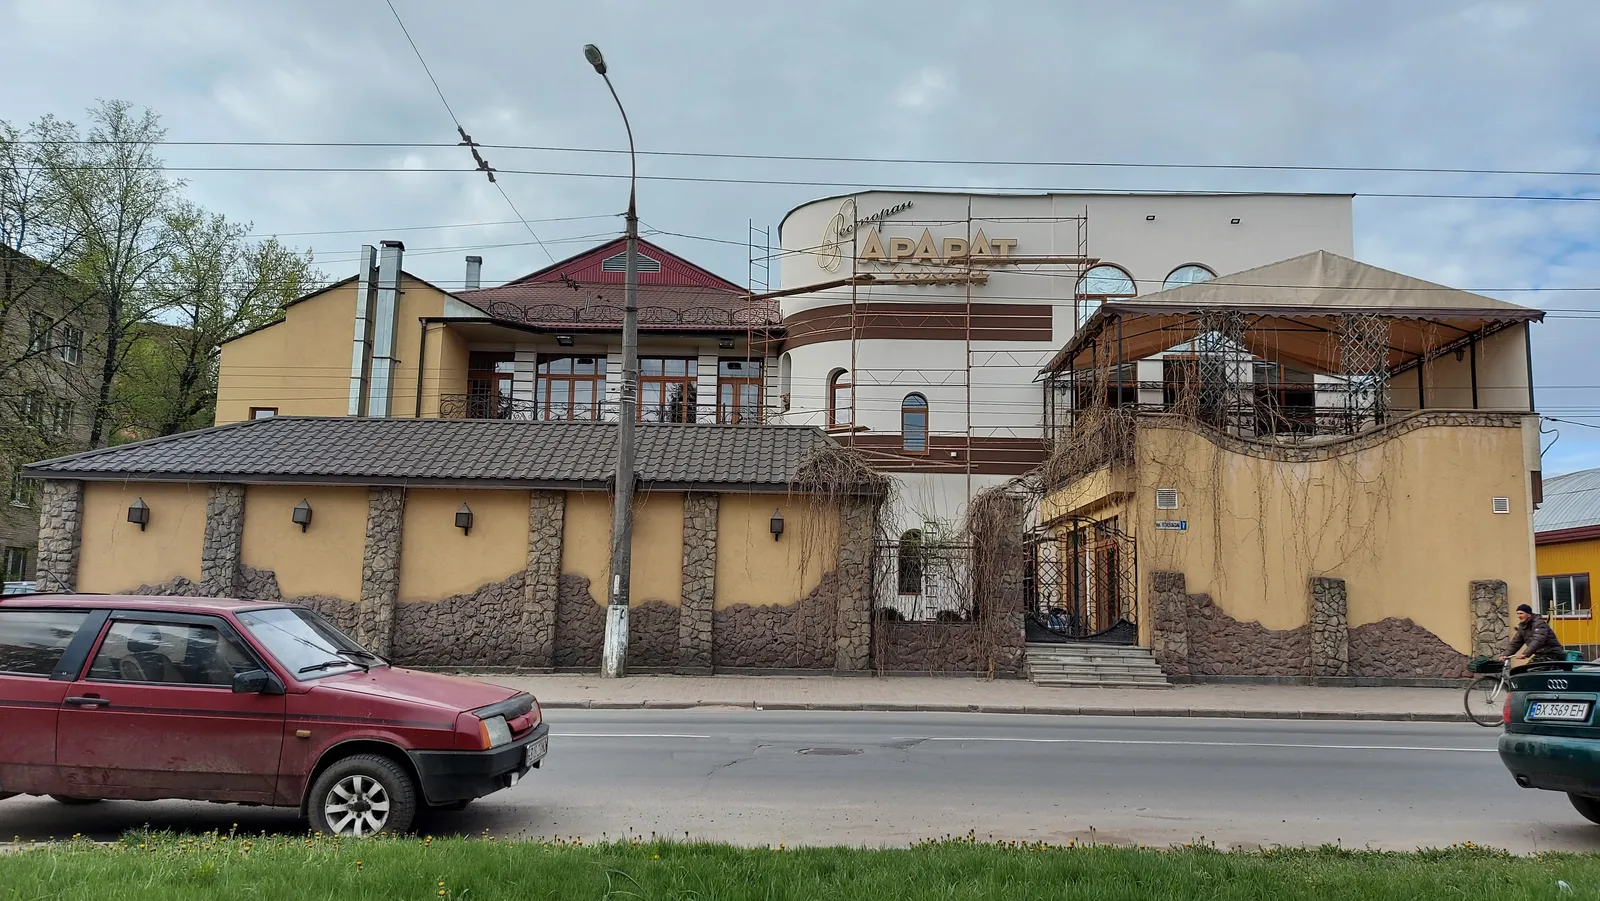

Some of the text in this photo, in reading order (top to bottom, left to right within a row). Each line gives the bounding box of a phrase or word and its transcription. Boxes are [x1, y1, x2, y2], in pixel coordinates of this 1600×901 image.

[858, 227, 1018, 266] АРАРАТ
[1535, 704, 1585, 717] BX 3569 EH
